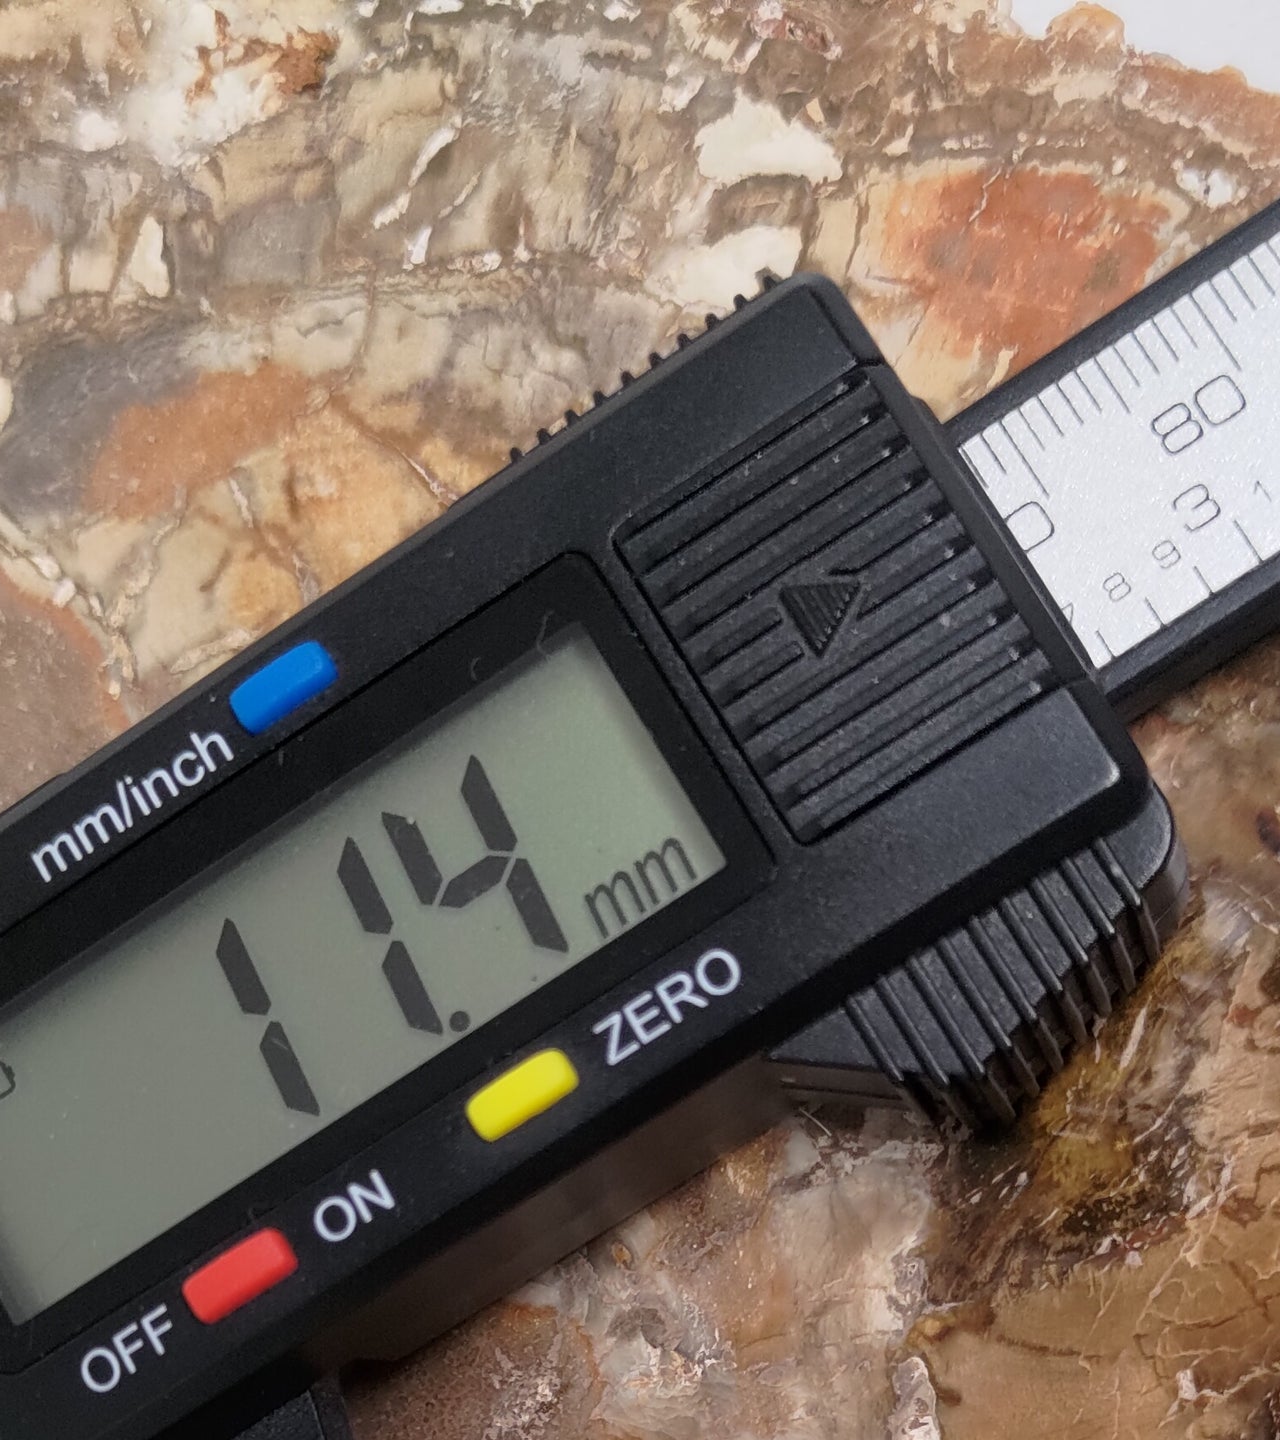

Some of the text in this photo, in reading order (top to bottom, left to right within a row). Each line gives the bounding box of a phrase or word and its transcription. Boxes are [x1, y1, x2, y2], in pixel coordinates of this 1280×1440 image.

[1150, 375, 1247, 455] 80
[1102, 571, 1132, 602] 8
[1151, 539, 1181, 569] 9
[1172, 483, 1222, 532] 3
[1252, 480, 1272, 502] 1
[30, 731, 236, 883] mm/inch
[216, 754, 698, 1118] 11.4 mm
[592, 948, 741, 1066] ZERO
[313, 1169, 396, 1243] ON
[81, 1307, 175, 1394] OFF
